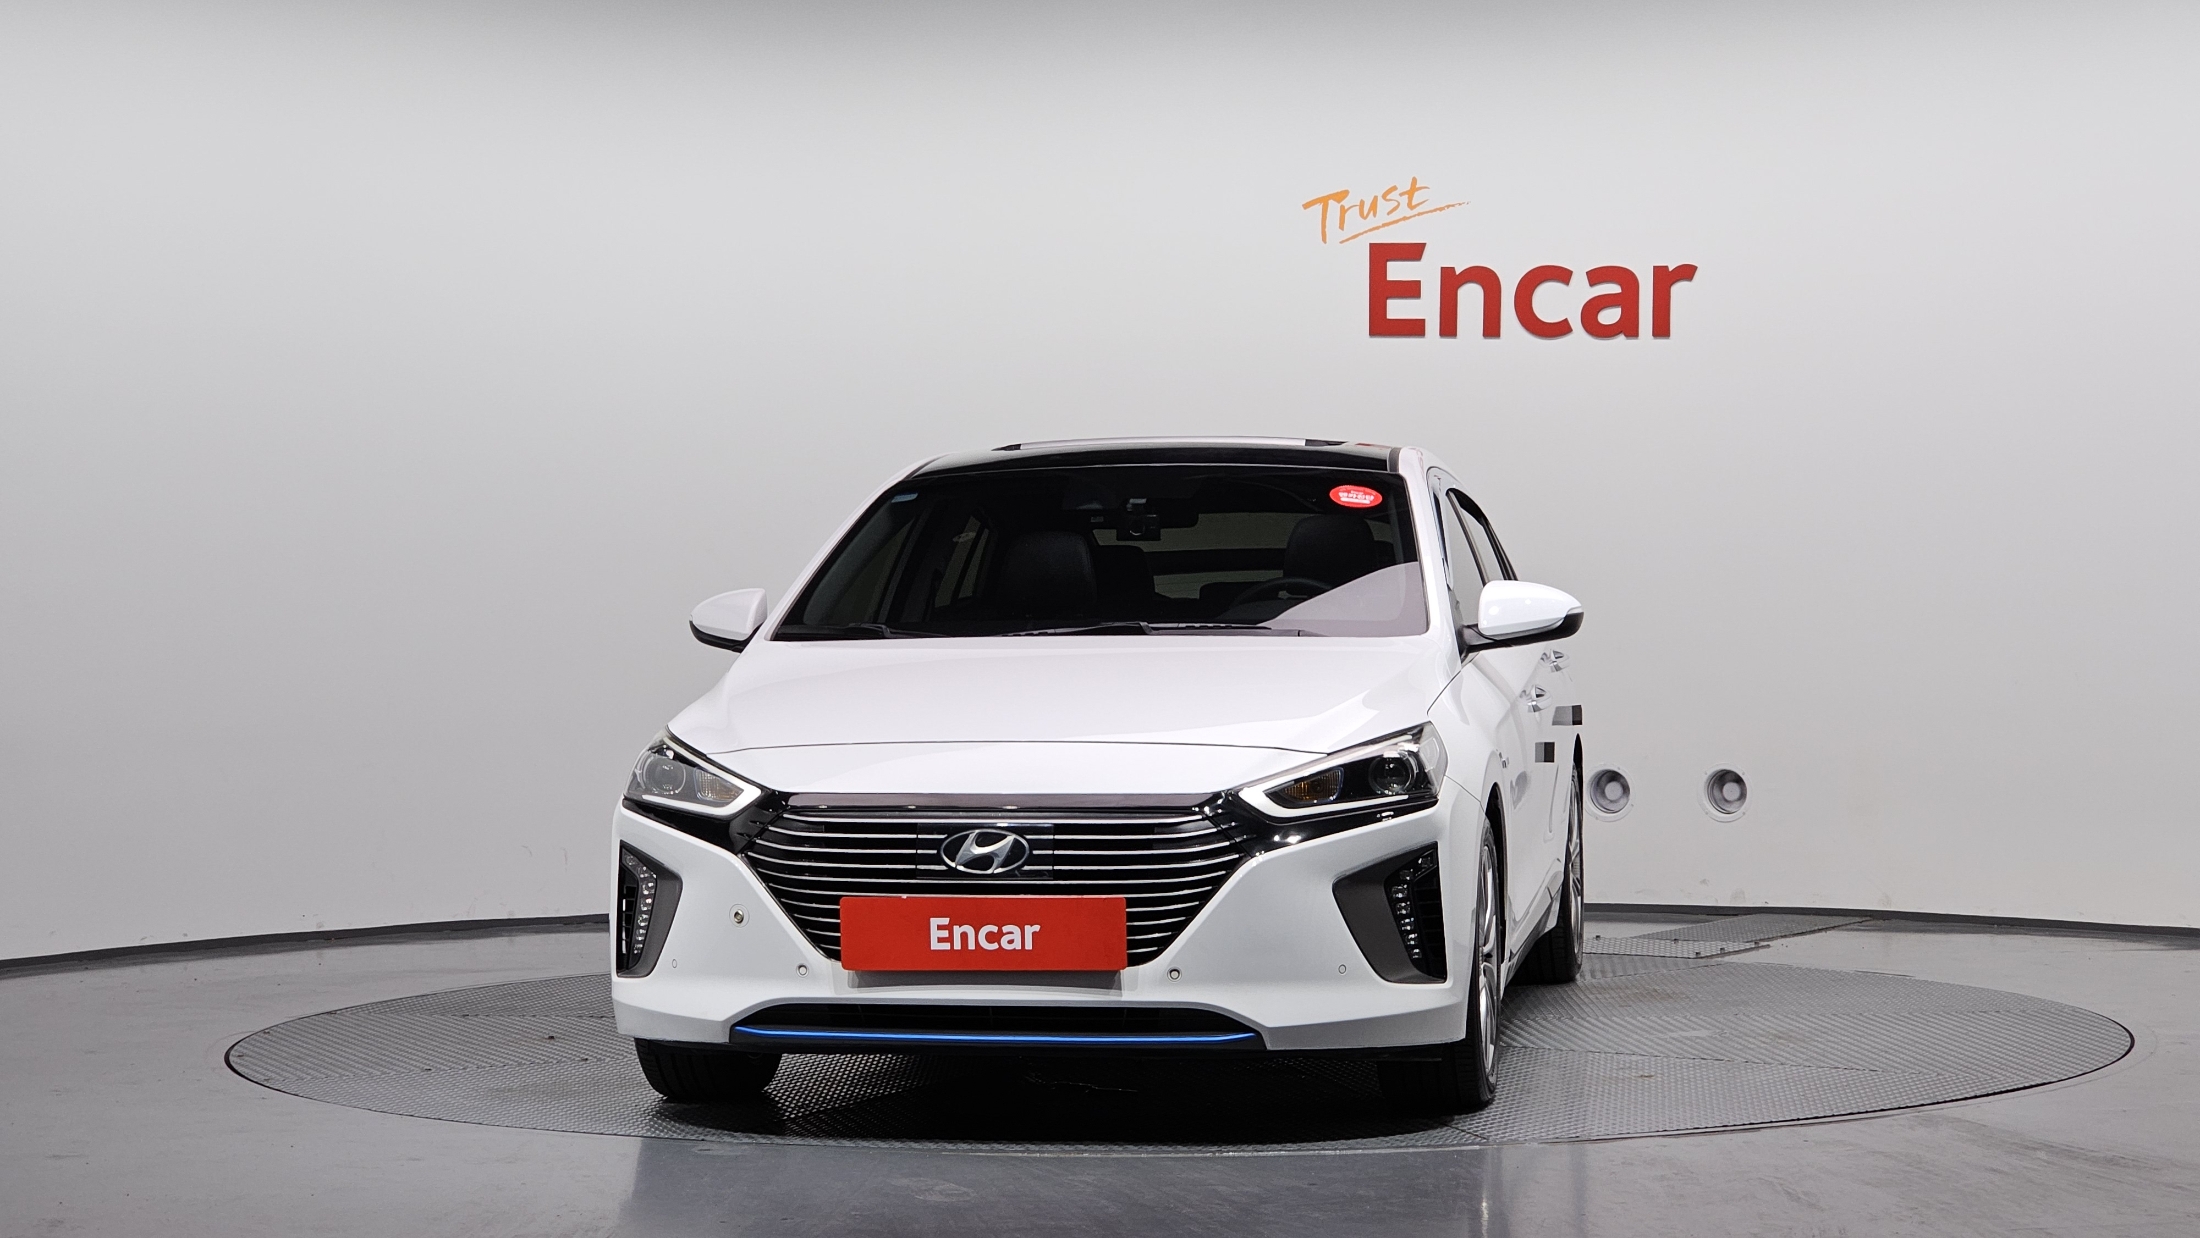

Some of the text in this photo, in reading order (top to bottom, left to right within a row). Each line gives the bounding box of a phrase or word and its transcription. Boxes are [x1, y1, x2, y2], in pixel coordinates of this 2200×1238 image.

[1302, 176, 1432, 243] Trust
[1369, 242, 1698, 339] Encar
[930, 917, 1041, 950] Encar
